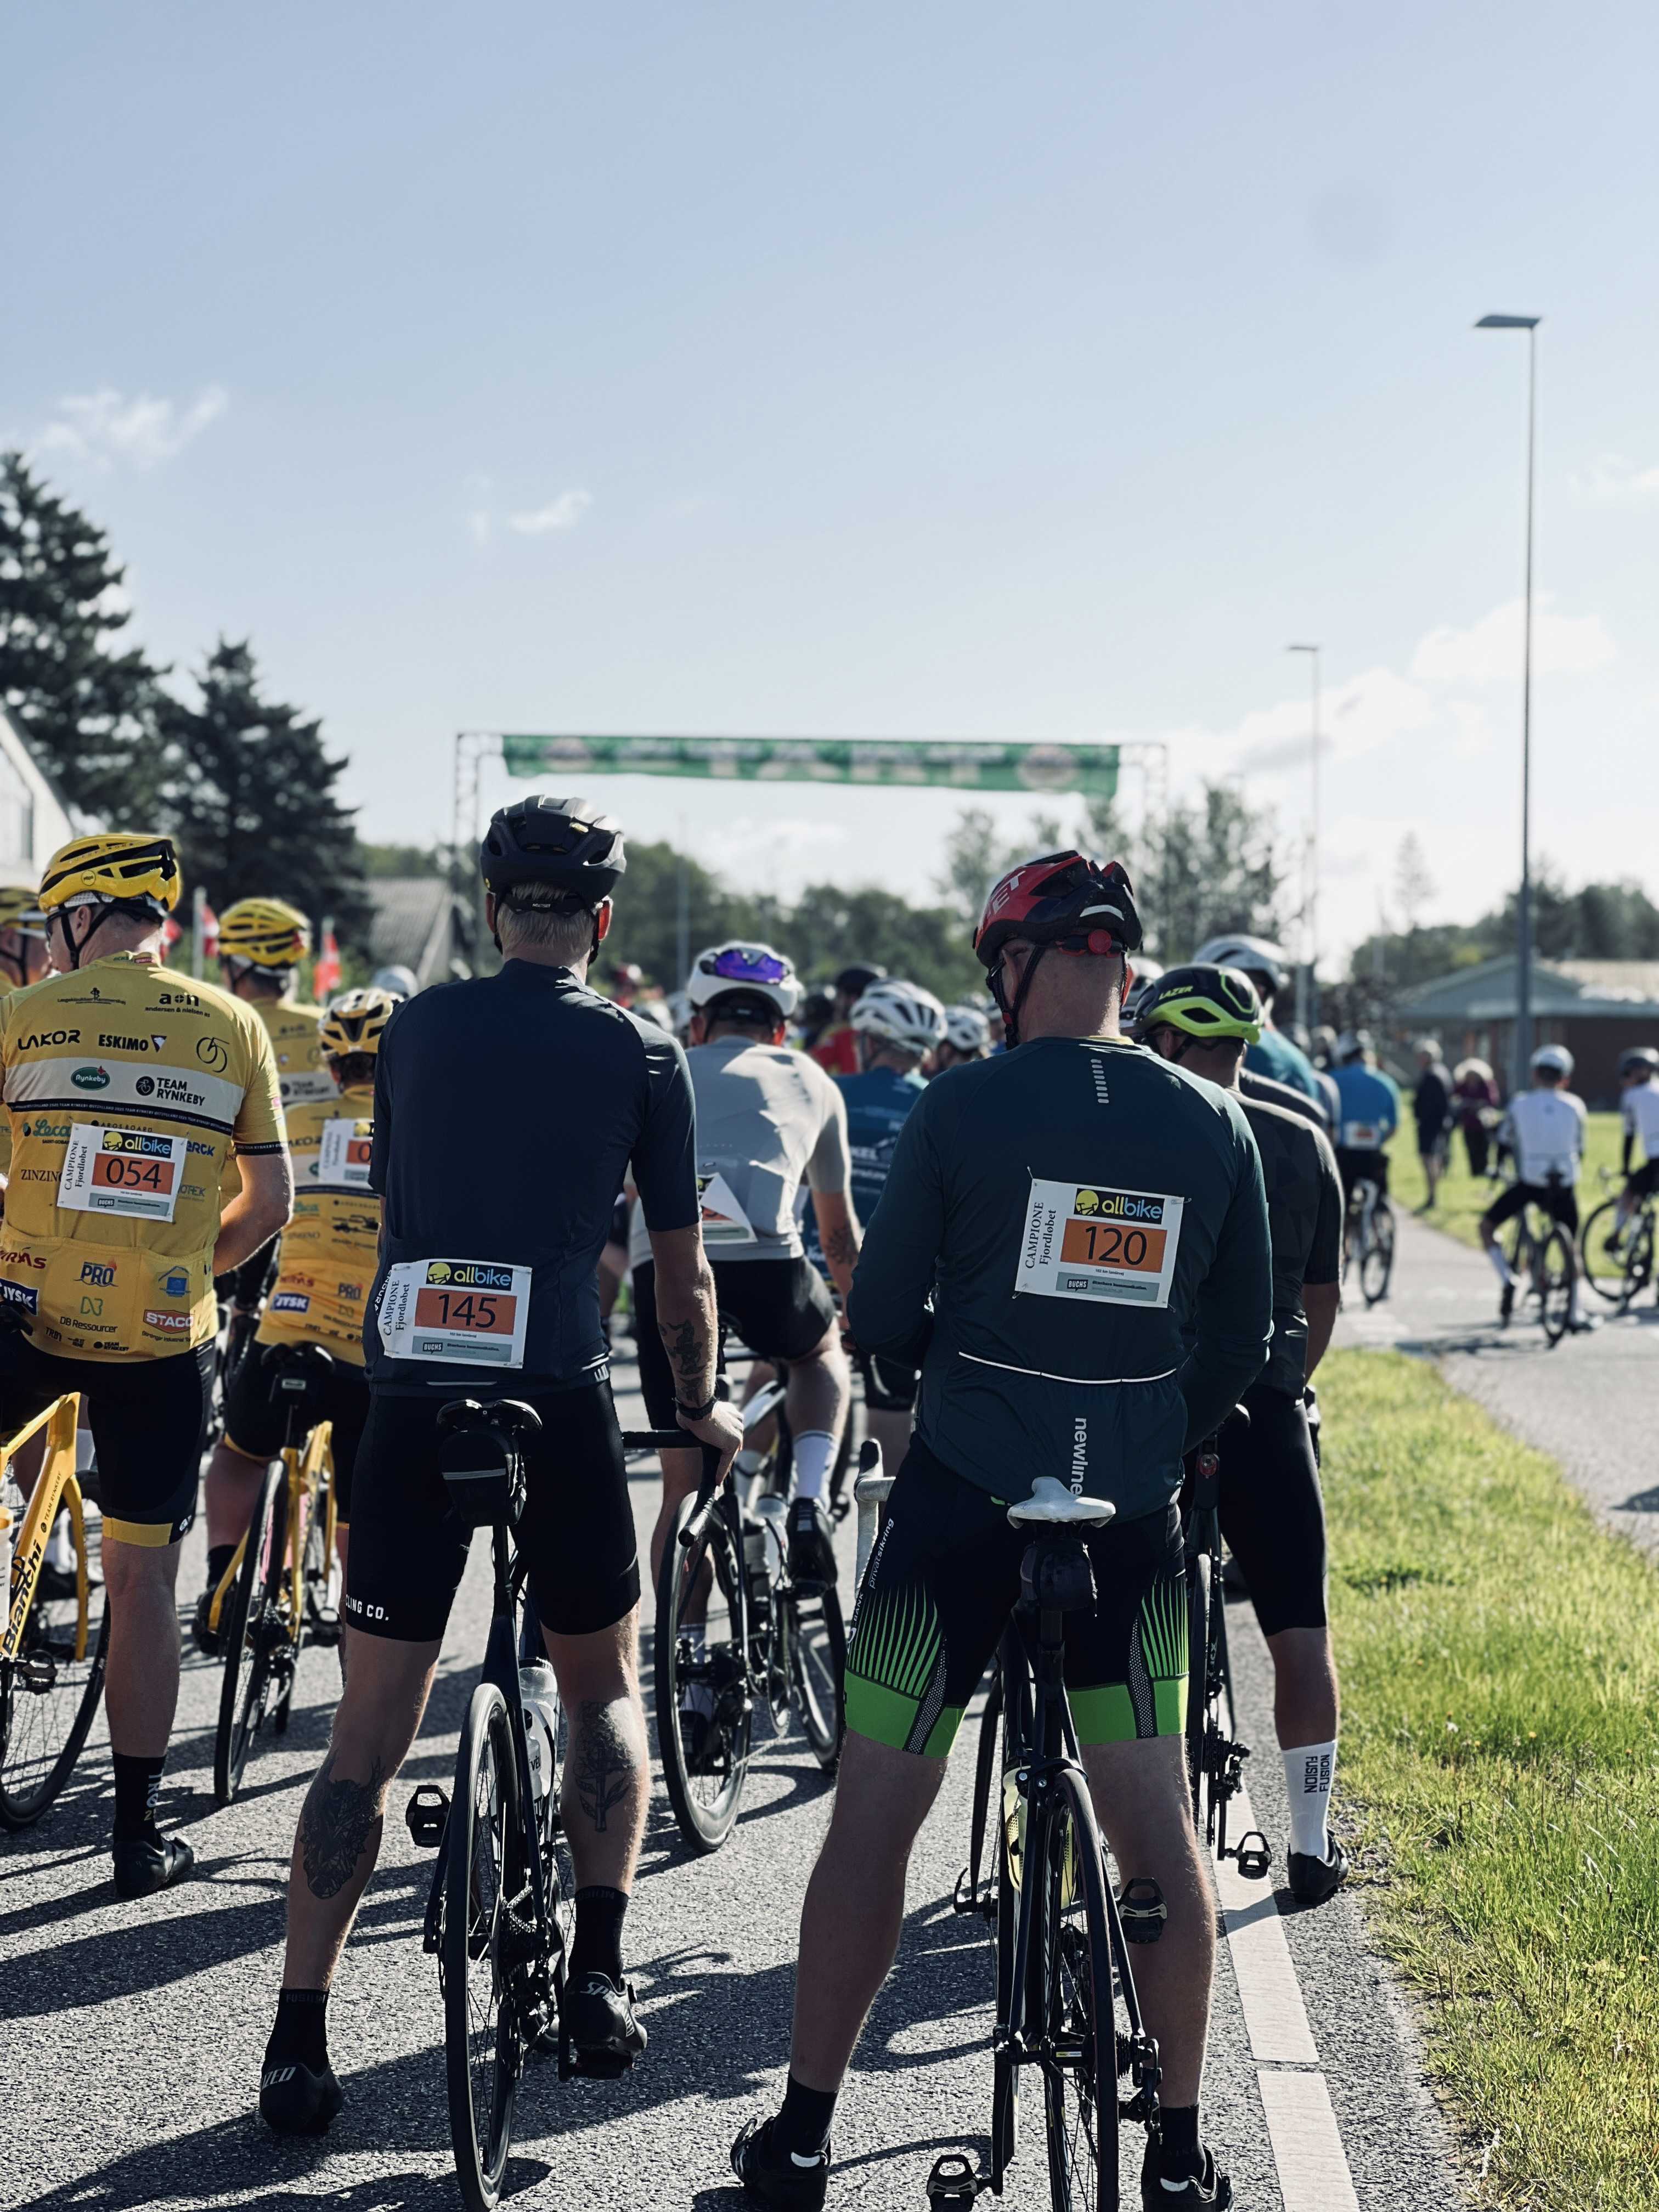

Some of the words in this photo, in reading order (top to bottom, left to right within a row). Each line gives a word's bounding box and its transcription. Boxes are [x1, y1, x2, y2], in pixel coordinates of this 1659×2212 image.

[1159, 986, 1193, 1000] LAZER
[98, 1034, 149, 1052] ESKIMO
[76, 1074, 106, 1084] Rynkeby
[157, 1077, 188, 1091] TEAM
[157, 1089, 206, 1107] RYNKEBY
[30, 1119, 71, 1137] Leca
[125, 1136, 171, 1154] allbike
[21, 1169, 62, 1182] ZINZIN
[64, 1140, 79, 1190] CAMPIONE
[75, 1146, 88, 1188] Fjordløbet
[106, 1158, 162, 1189] 054
[1102, 1195, 1163, 1219] allbike
[1025, 1201, 1044, 1269] CAMPIONE
[1039, 1209, 1057, 1266] Fjordløbet
[1085, 1226, 1147, 1266] 120
[81, 1264, 115, 1285] PRO
[453, 1266, 512, 1286] allbike
[1069, 1280, 1087, 1289] BUCHS
[4, 1285, 33, 1309] JYSK
[276, 1296, 308, 1308] JYSK
[383, 1280, 400, 1336] CAMPIONE
[396, 1283, 410, 1331] Fjordløbet
[438, 1293, 497, 1328] 145
[60, 1316, 71, 1326] DB
[72, 1319, 118, 1333] Ressourcer
[424, 1342, 442, 1351] BUCHS
[1070, 1418, 1088, 1496] newline
[868, 1518, 894, 1589] privatsikring
[3, 1539, 42, 1650] Bianchi
[366, 1604, 389, 1621] CO.
[1304, 1756, 1318, 1793] FUSION
[1319, 1754, 1330, 1792] FUSION
